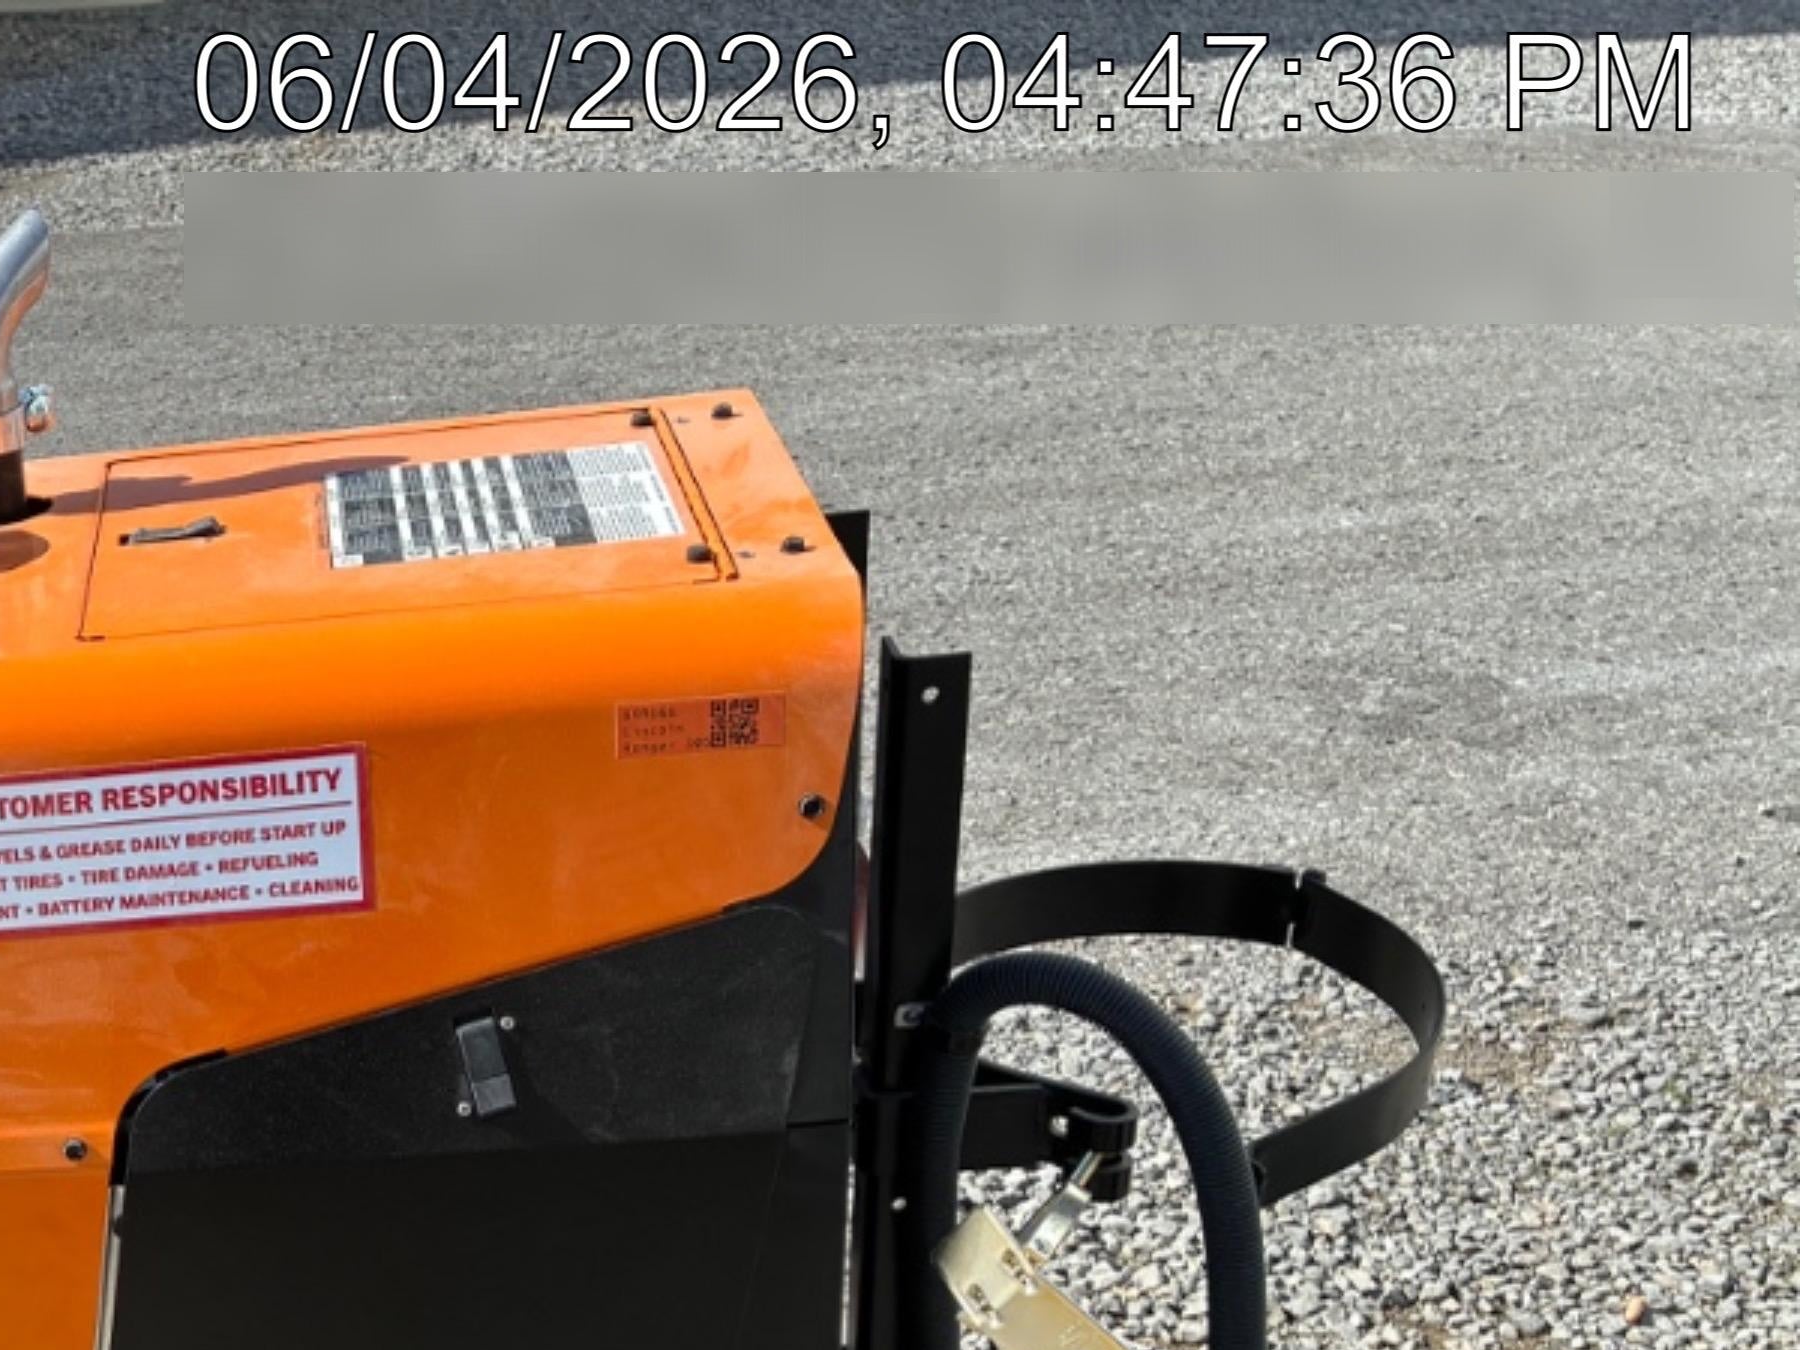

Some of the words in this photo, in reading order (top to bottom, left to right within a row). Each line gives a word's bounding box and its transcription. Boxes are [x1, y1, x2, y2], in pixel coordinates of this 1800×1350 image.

[101, 767, 342, 812] RESPONSIBILITY
[39, 845, 53, 860] &
[56, 839, 125, 859] GREASE
[130, 833, 181, 852] DAILY
[185, 827, 256, 848] BEFORE
[260, 822, 316, 841] START
[320, 819, 347, 836] UP
[12, 873, 63, 892] TIRES
[80, 866, 120, 885] TIRE
[124, 860, 199, 882] DAMAGE
[218, 851, 319, 874] REFUELING
[38, 896, 115, 917] BATTERY
[119, 885, 250, 912] MAINTENANCE
[268, 876, 359, 898] CLEANING
